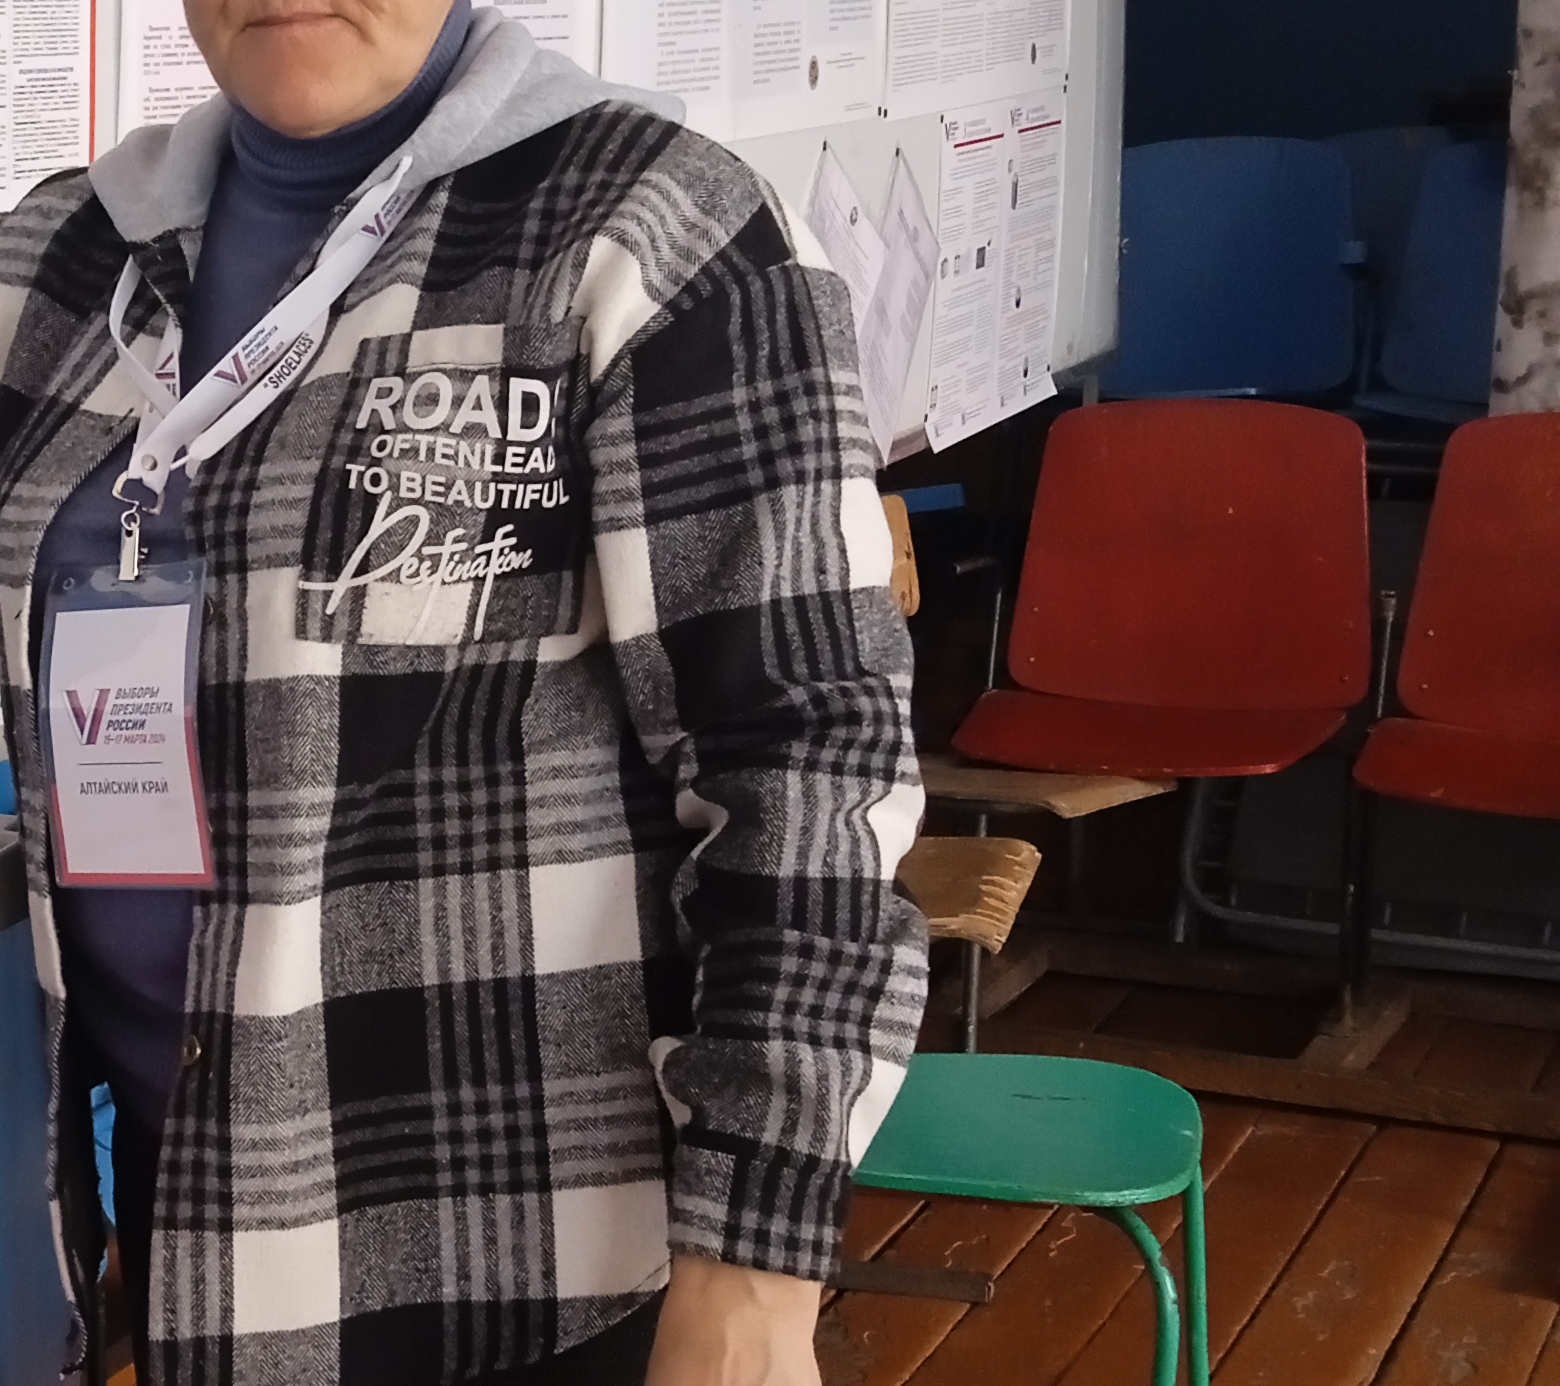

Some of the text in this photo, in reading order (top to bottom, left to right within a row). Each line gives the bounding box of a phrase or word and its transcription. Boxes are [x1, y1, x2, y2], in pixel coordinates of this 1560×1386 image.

[355, 371, 561, 443] ROAD
[345, 463, 571, 510] TO BEAUTIFUL
[114, 686, 160, 700] ВЫБОРЫ
[110, 701, 173, 716] ПРЕЗИДЕНТА
[105, 718, 147, 732] РОССИИ
[79, 776, 170, 795] АЛТАЙСКИЙ КРАЙ
